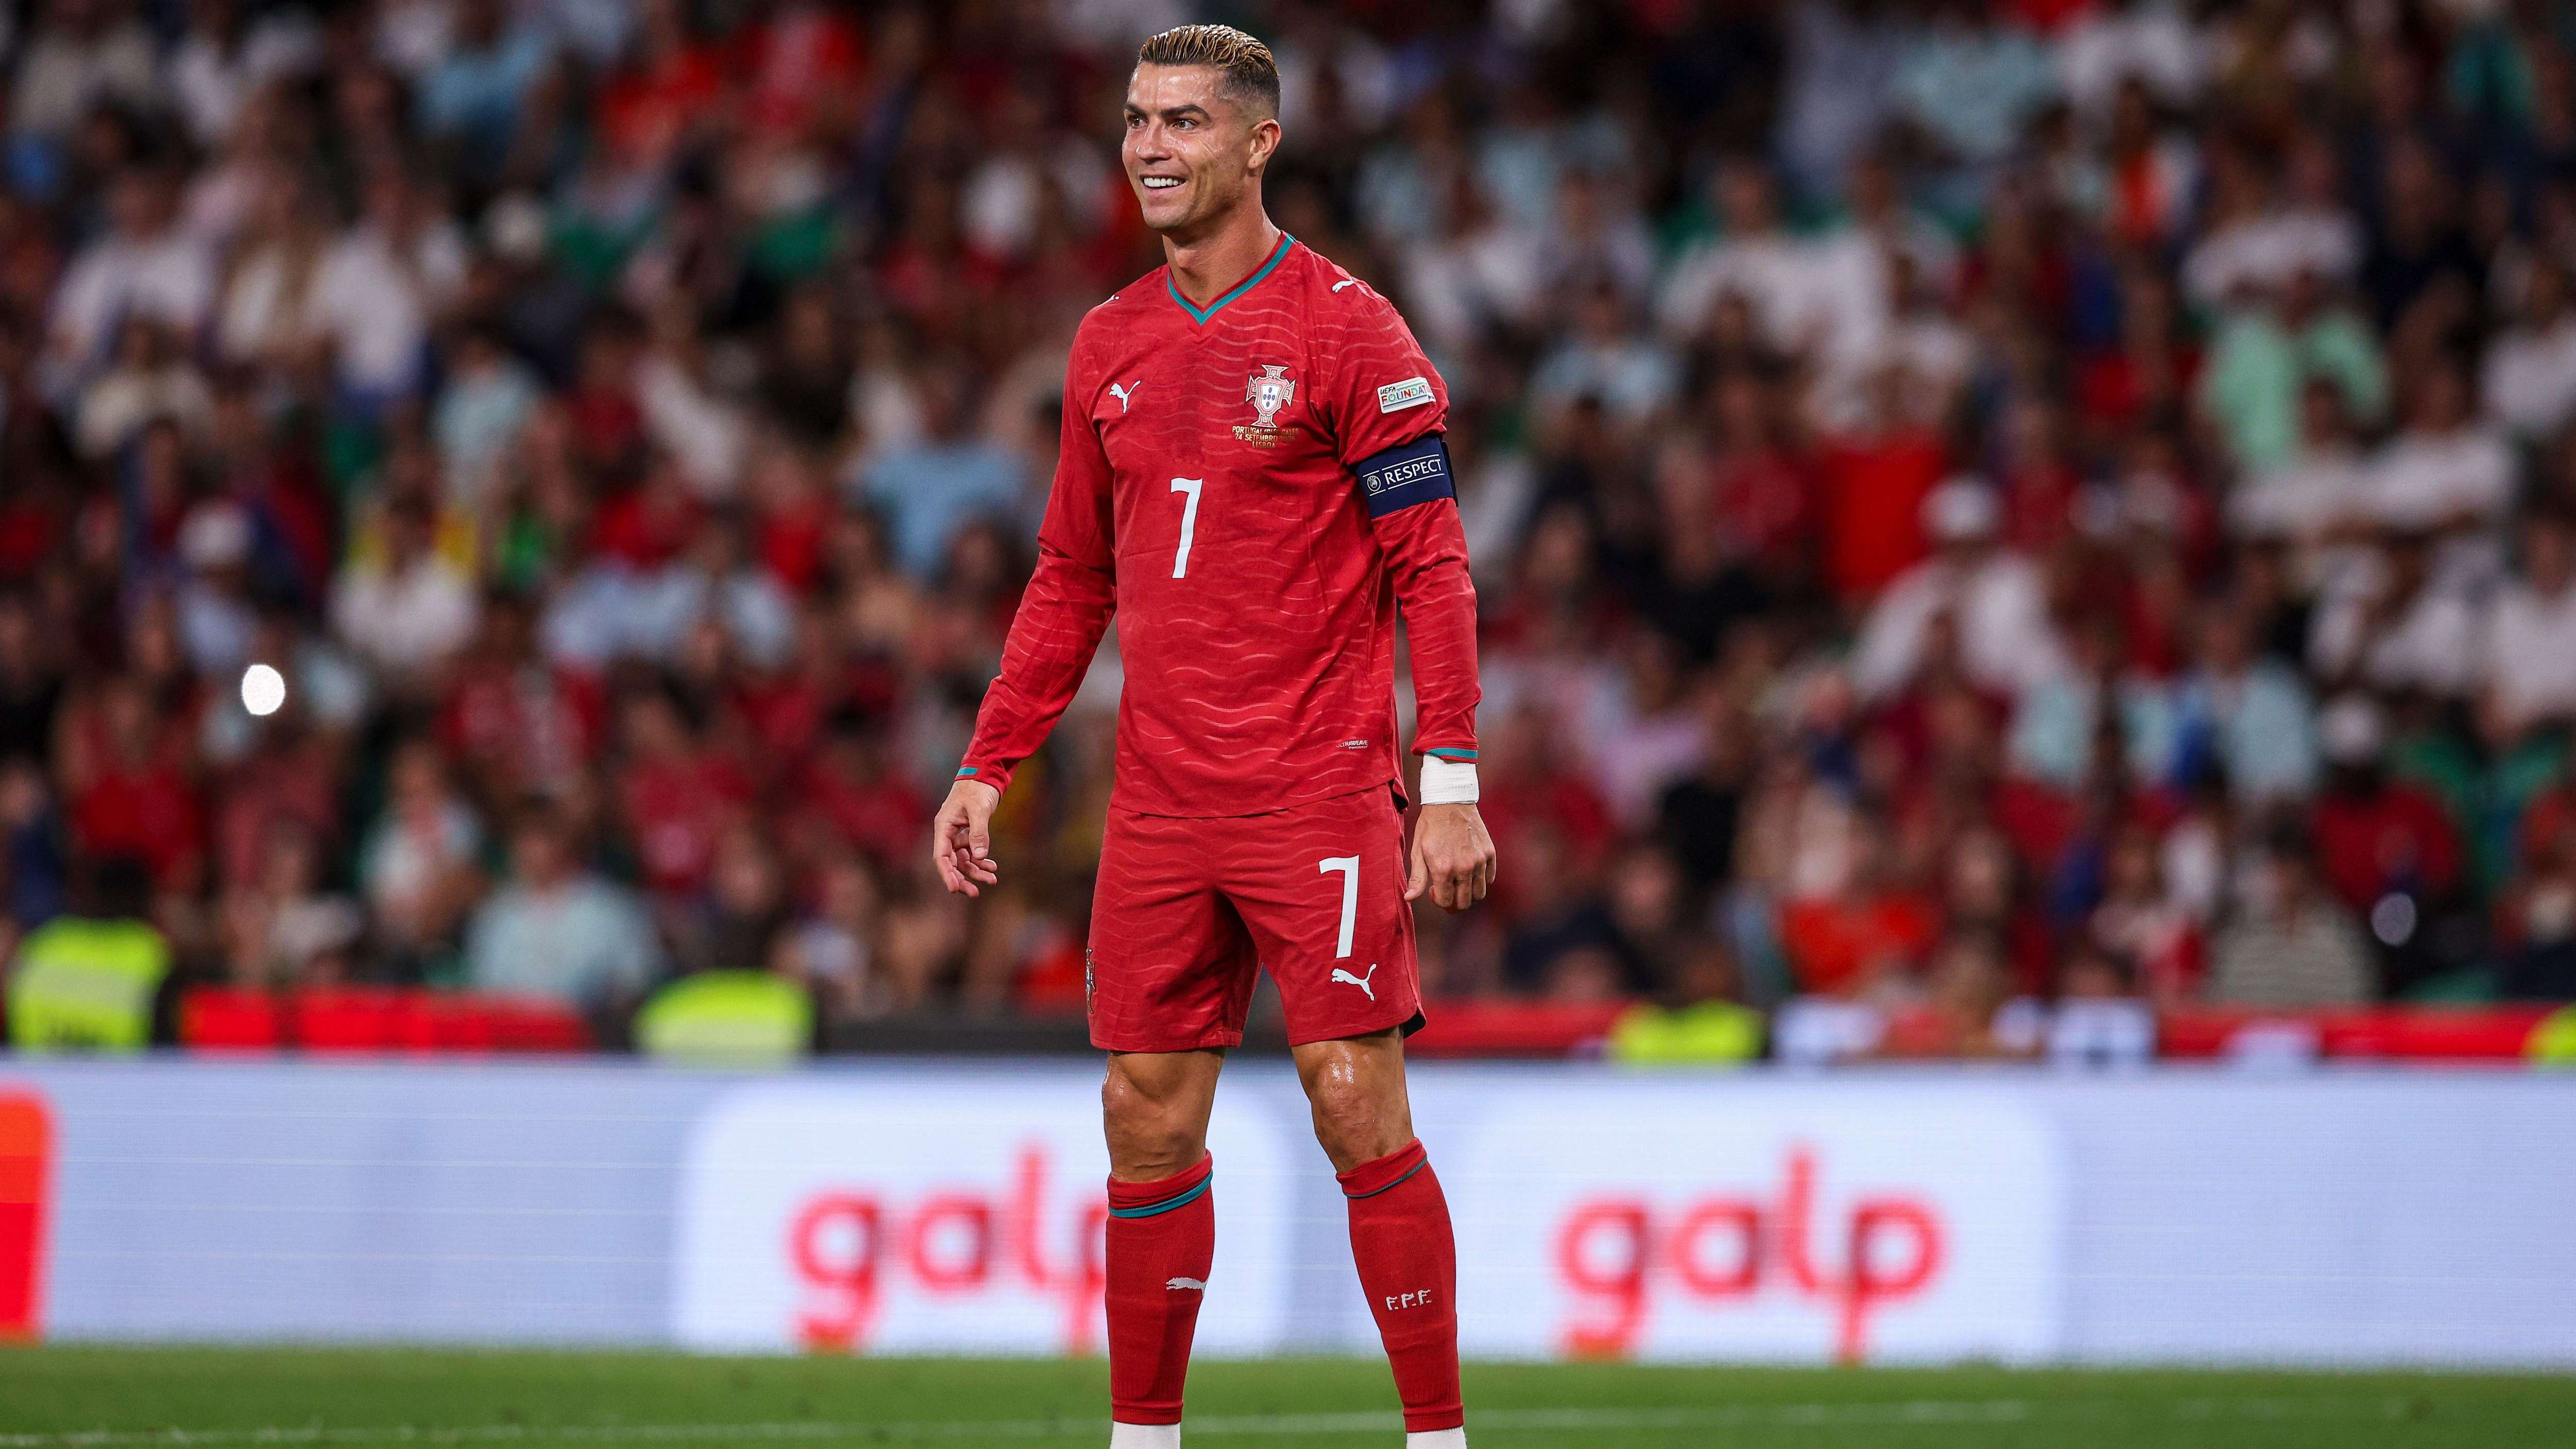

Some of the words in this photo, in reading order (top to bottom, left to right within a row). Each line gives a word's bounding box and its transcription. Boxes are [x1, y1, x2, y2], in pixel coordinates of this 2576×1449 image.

[1380, 386, 1396, 395] UEFA
[1381, 385, 1429, 405] FOUNDAT
[1232, 426, 1263, 435] PORTUGAL
[1245, 433, 1278, 442] SETEMBRO
[1252, 441, 1276, 449] LISBOA
[1384, 459, 1442, 485] RESPECT
[1170, 477, 1203, 579] 7
[1319, 854, 1360, 959] 7
[1557, 1144, 1944, 1367] galp
[1386, 1289, 1432, 1311] F.P.F.
